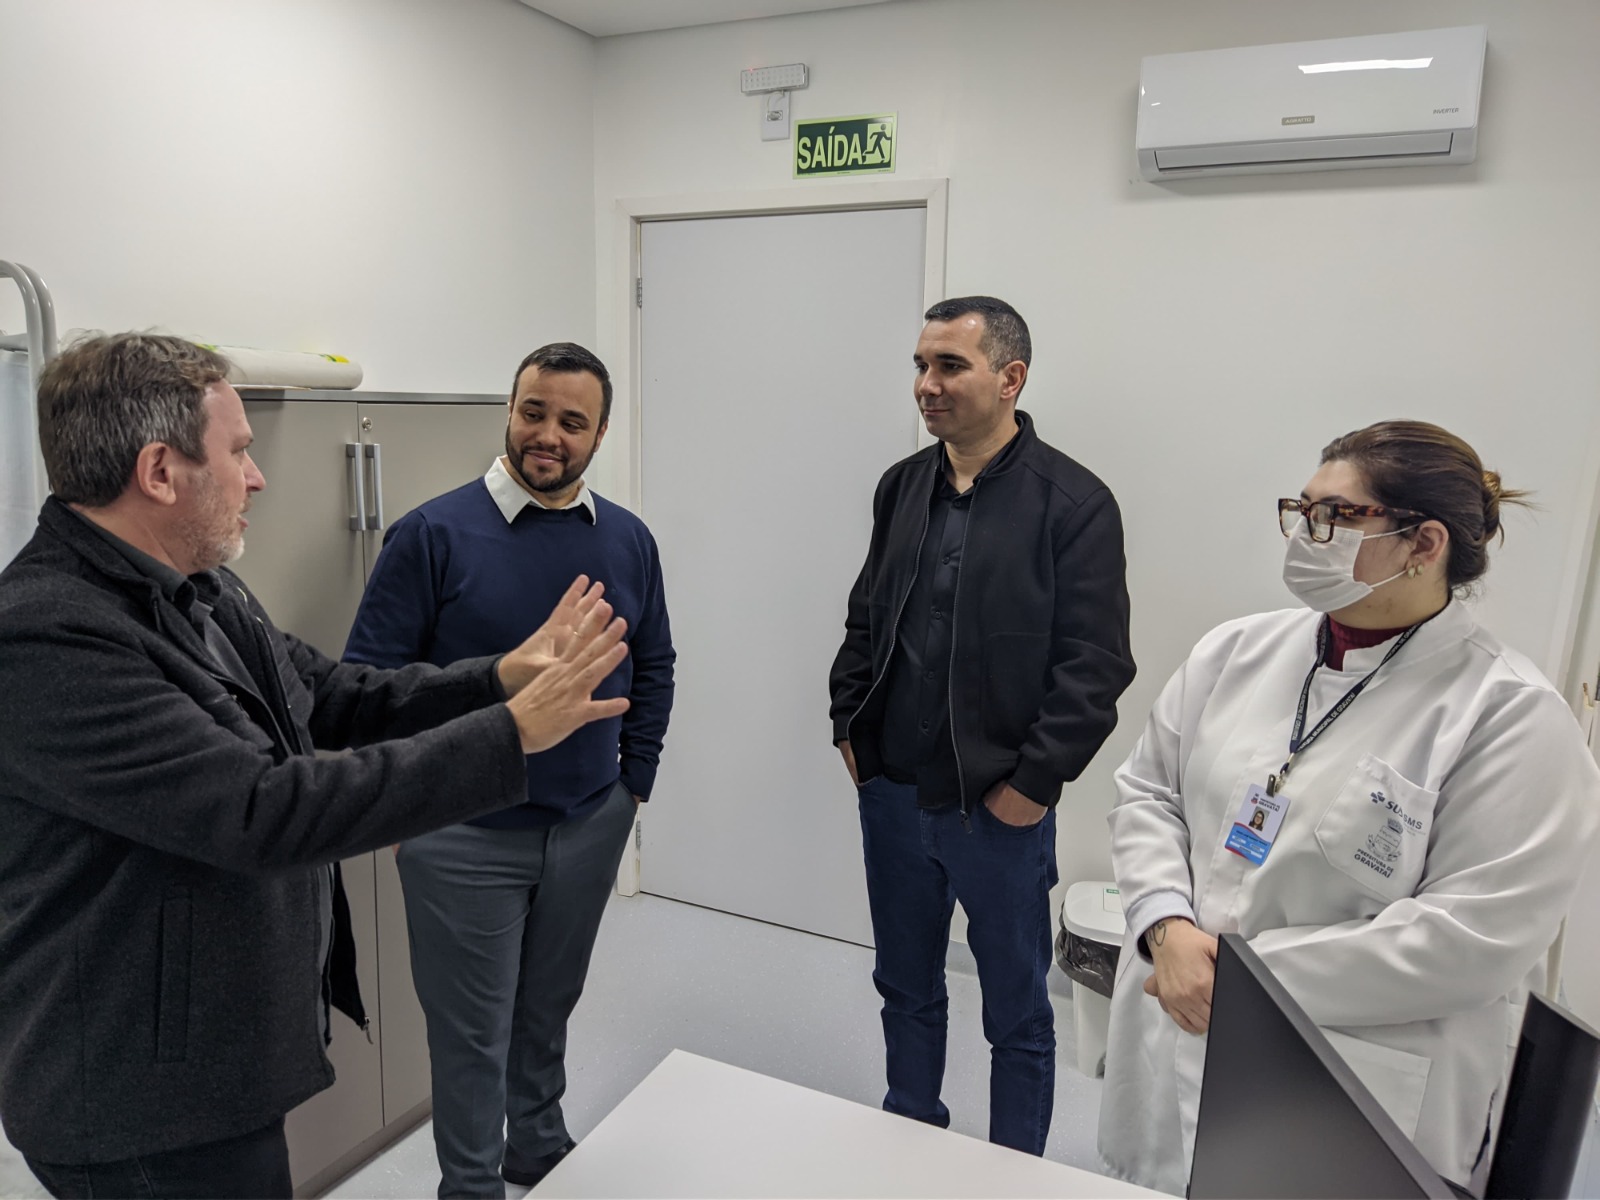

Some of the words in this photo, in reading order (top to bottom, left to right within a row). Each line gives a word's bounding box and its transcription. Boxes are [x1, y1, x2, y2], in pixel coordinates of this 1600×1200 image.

[798, 126, 863, 170] SAÍDA
[1330, 710, 1339, 719] DE
[1357, 848, 1386, 868] PREFEITURA
[1386, 865, 1394, 873] DE
